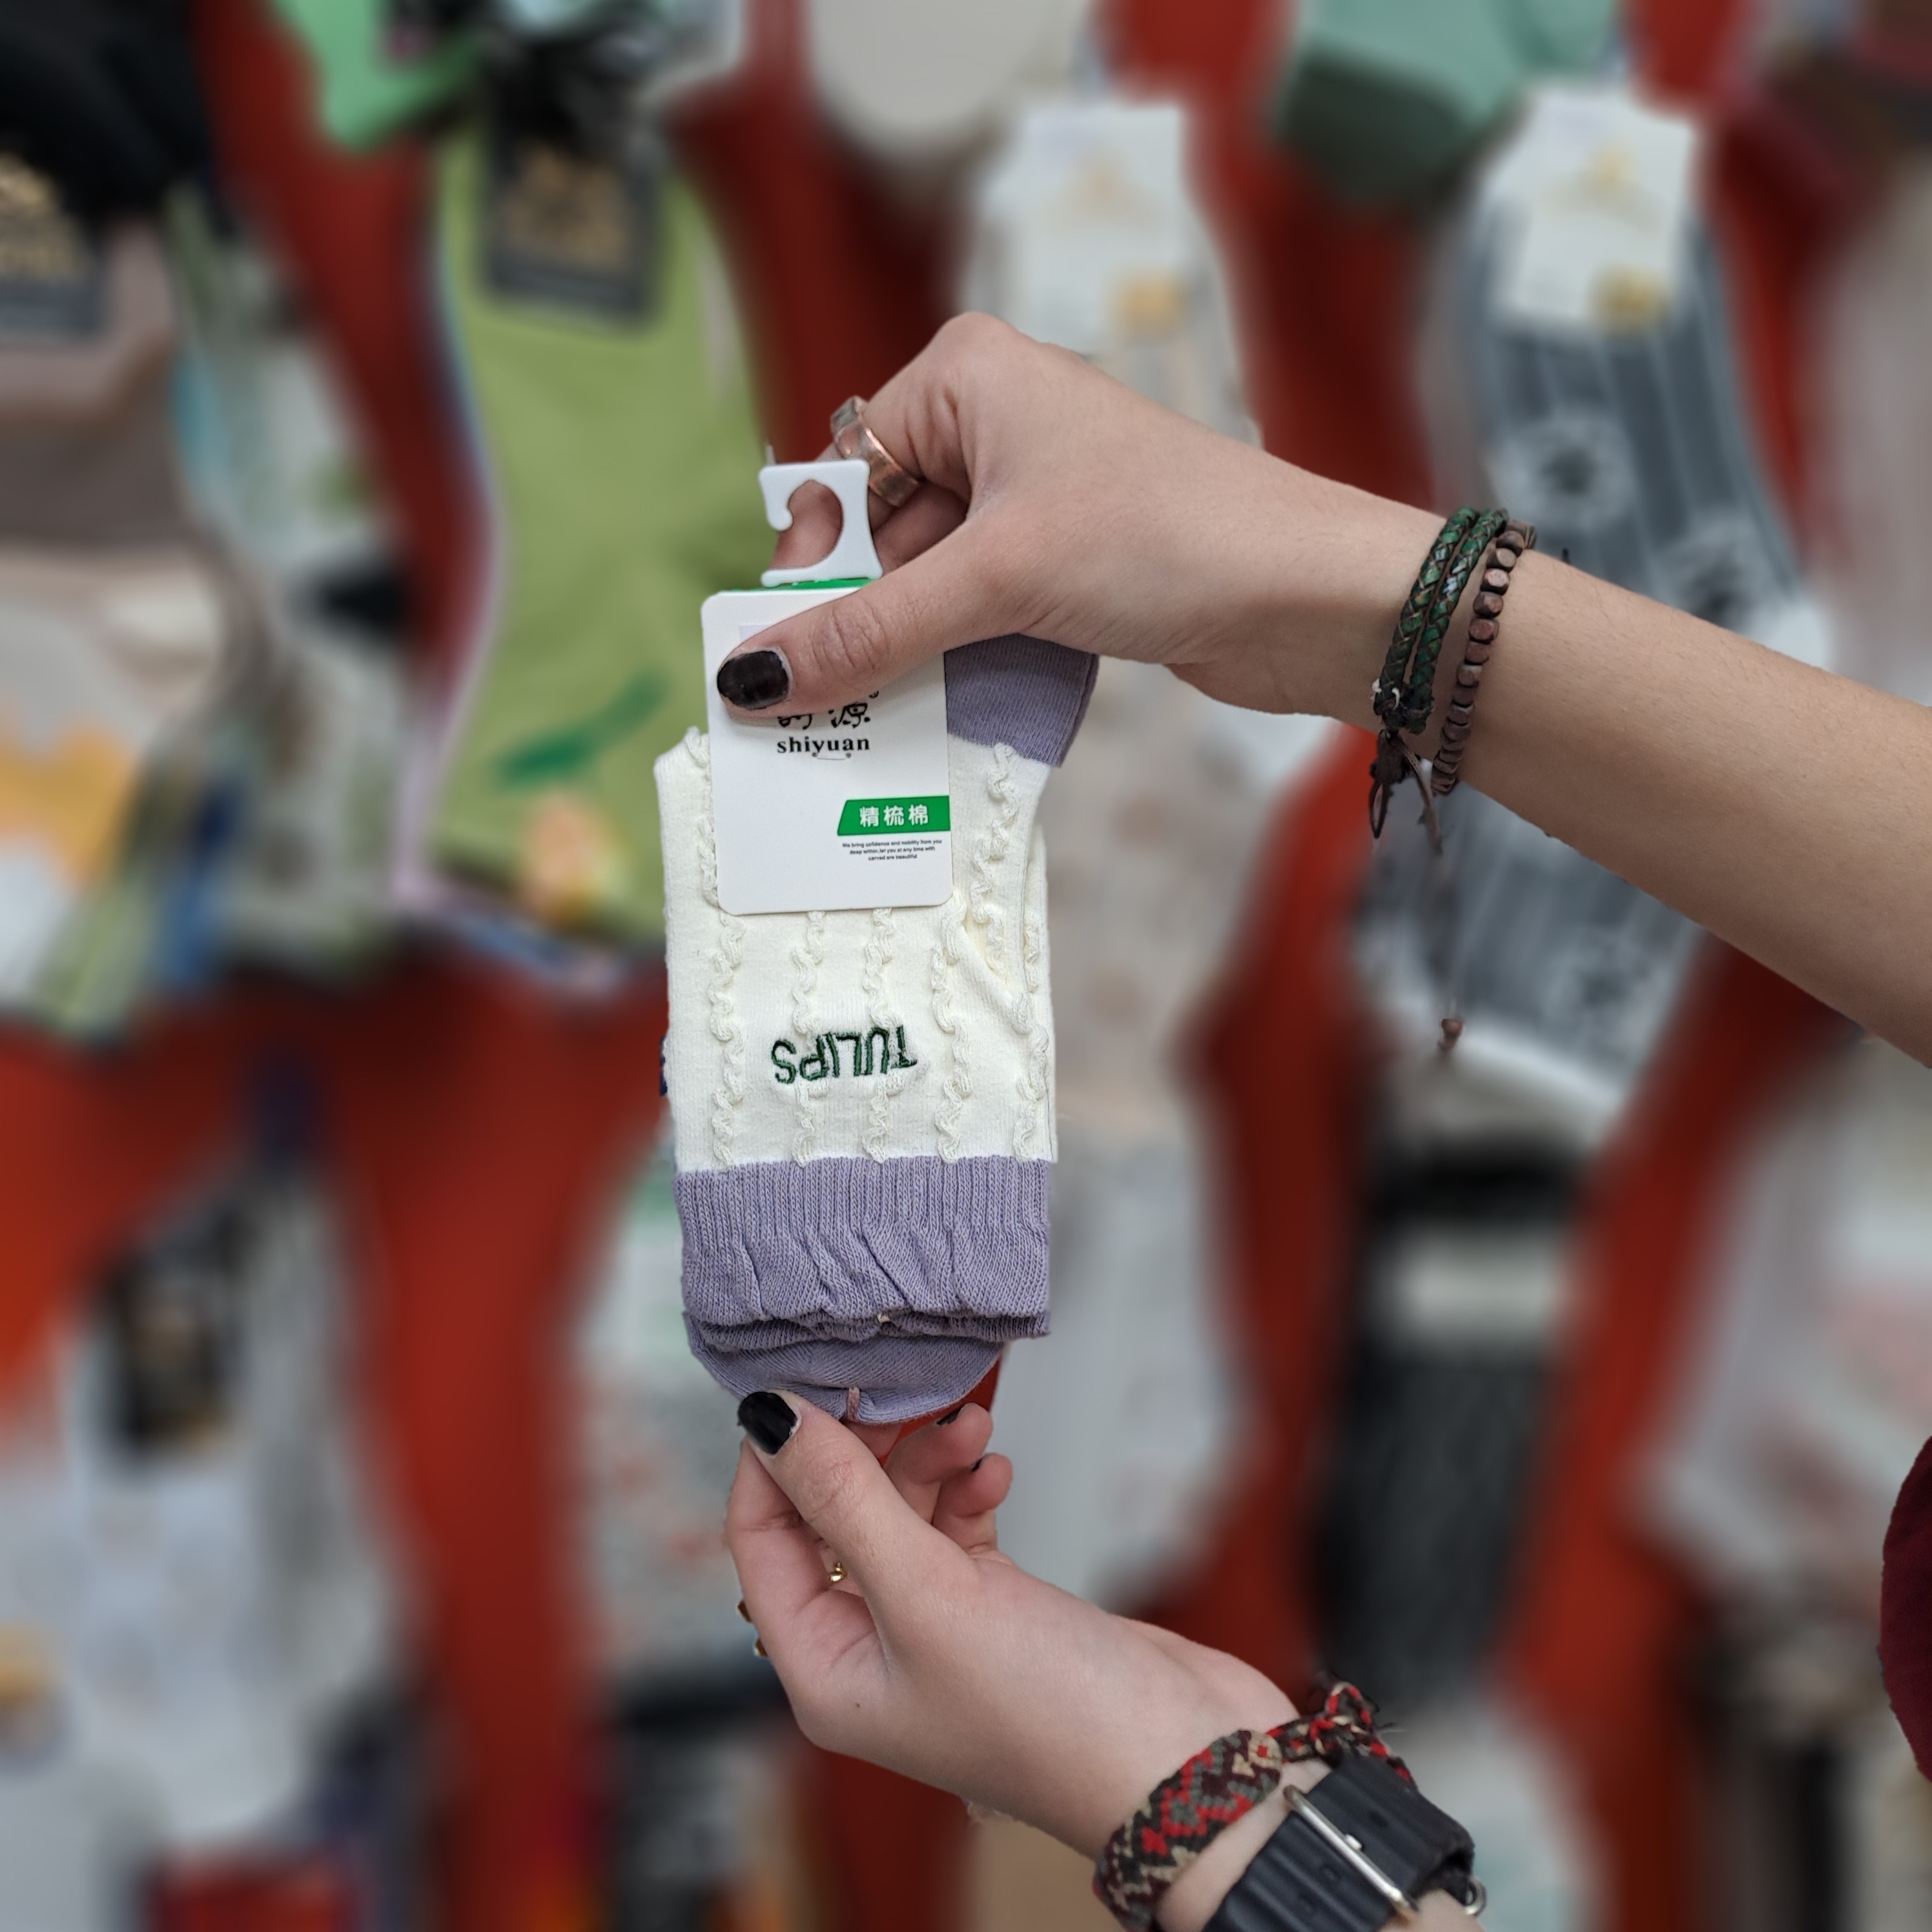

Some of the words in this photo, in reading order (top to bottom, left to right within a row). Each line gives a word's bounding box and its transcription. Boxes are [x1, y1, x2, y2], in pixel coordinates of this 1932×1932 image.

[777, 735, 870, 754] shiyuan
[859, 804, 929, 828] 精梳棉
[771, 1024, 918, 1085] TULIPS
